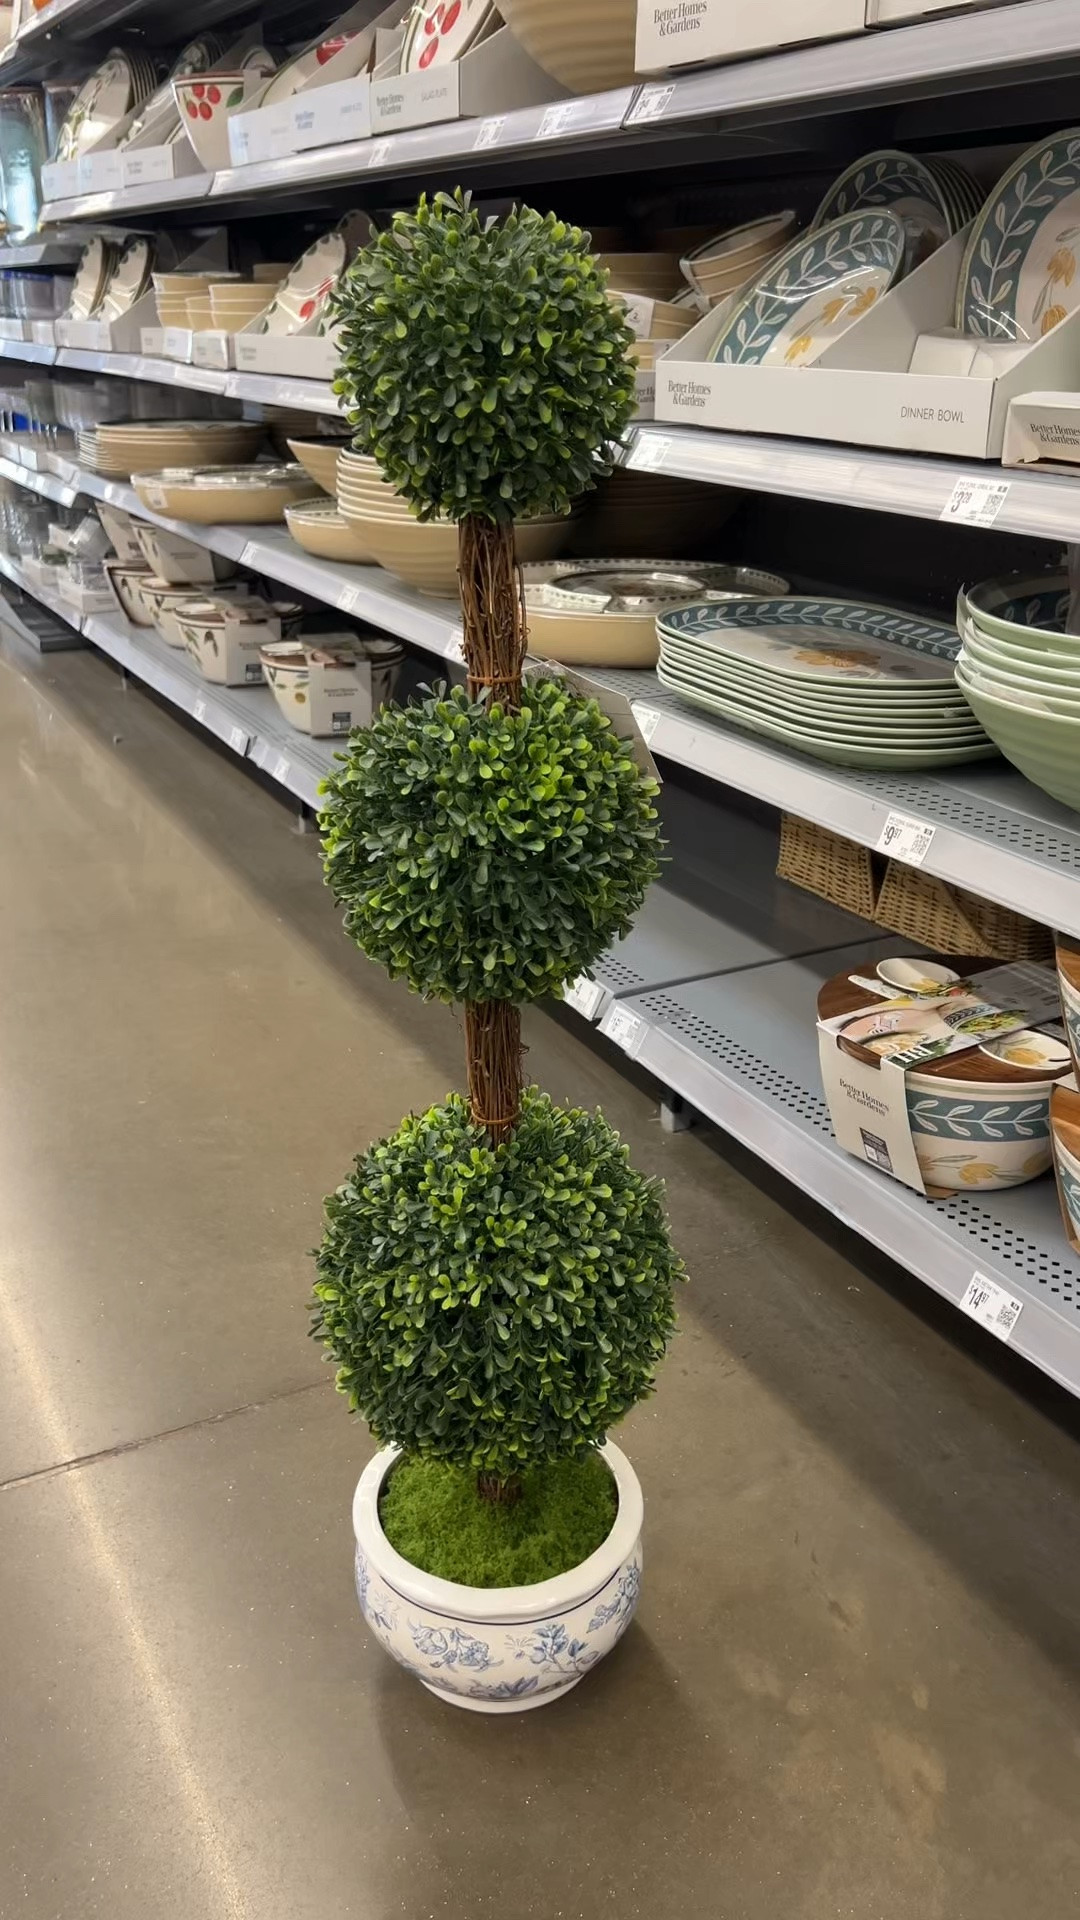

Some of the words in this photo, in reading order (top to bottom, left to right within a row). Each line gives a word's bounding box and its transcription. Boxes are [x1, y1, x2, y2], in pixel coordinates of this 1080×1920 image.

[654, 8, 678, 24] Better
[678, 1, 708, 17] Homes
[668, 379, 688, 393] Better
[688, 381, 711, 395] Homes
[900, 406, 935, 420] DINNER
[937, 408, 965, 424] BOWL
[1030, 423, 1054, 433] Better
[839, 1078, 861, 1097] Better
[861, 1090, 889, 1112] Homes
